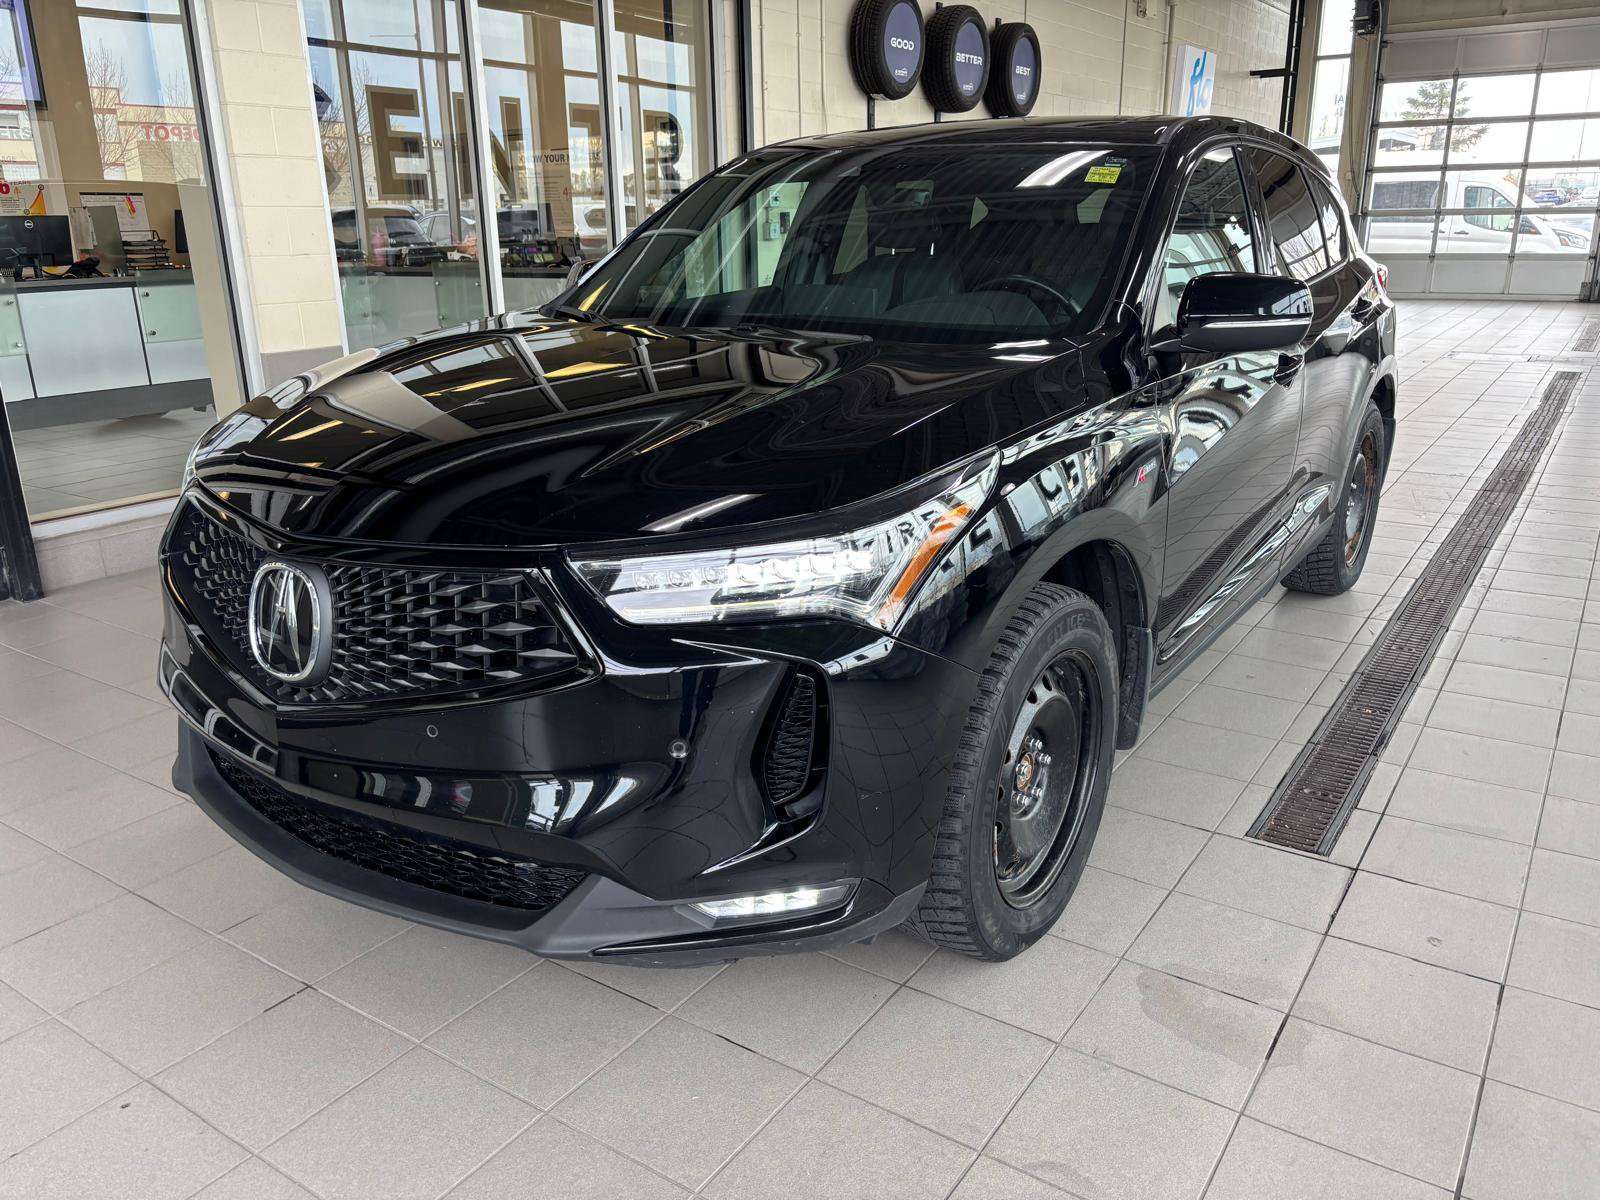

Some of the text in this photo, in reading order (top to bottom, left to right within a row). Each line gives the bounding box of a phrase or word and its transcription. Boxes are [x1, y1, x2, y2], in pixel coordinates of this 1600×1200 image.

[891, 37, 914, 51] GOOD
[956, 52, 982, 66] BETTER
[1016, 65, 1031, 76] BEST
[544, 154, 565, 163] YOUR
